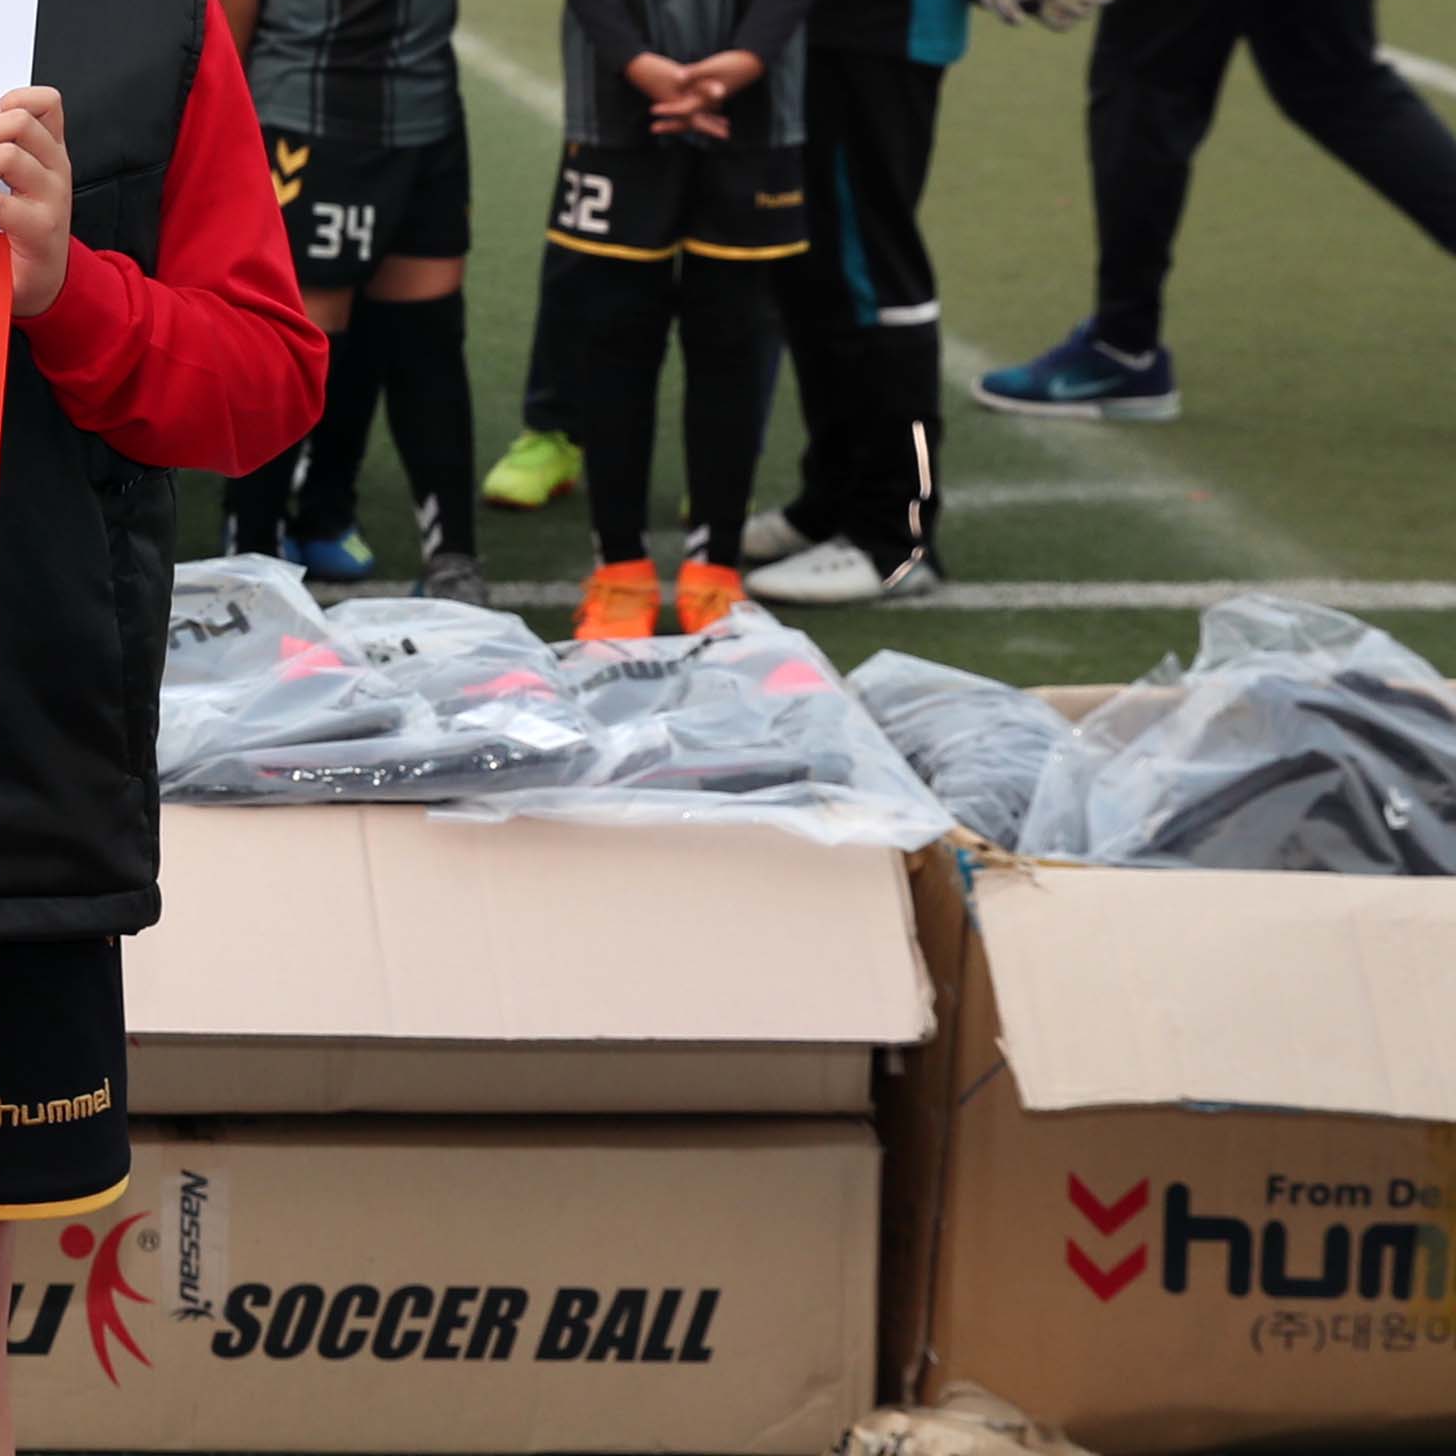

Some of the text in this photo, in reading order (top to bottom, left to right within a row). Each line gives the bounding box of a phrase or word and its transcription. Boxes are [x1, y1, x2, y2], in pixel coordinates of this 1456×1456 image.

[308, 201, 376, 261] 34
[558, 170, 615, 235] 32
[1266, 1175, 1373, 1207] From
[211, 1282, 722, 1364] SOCCER BALL
